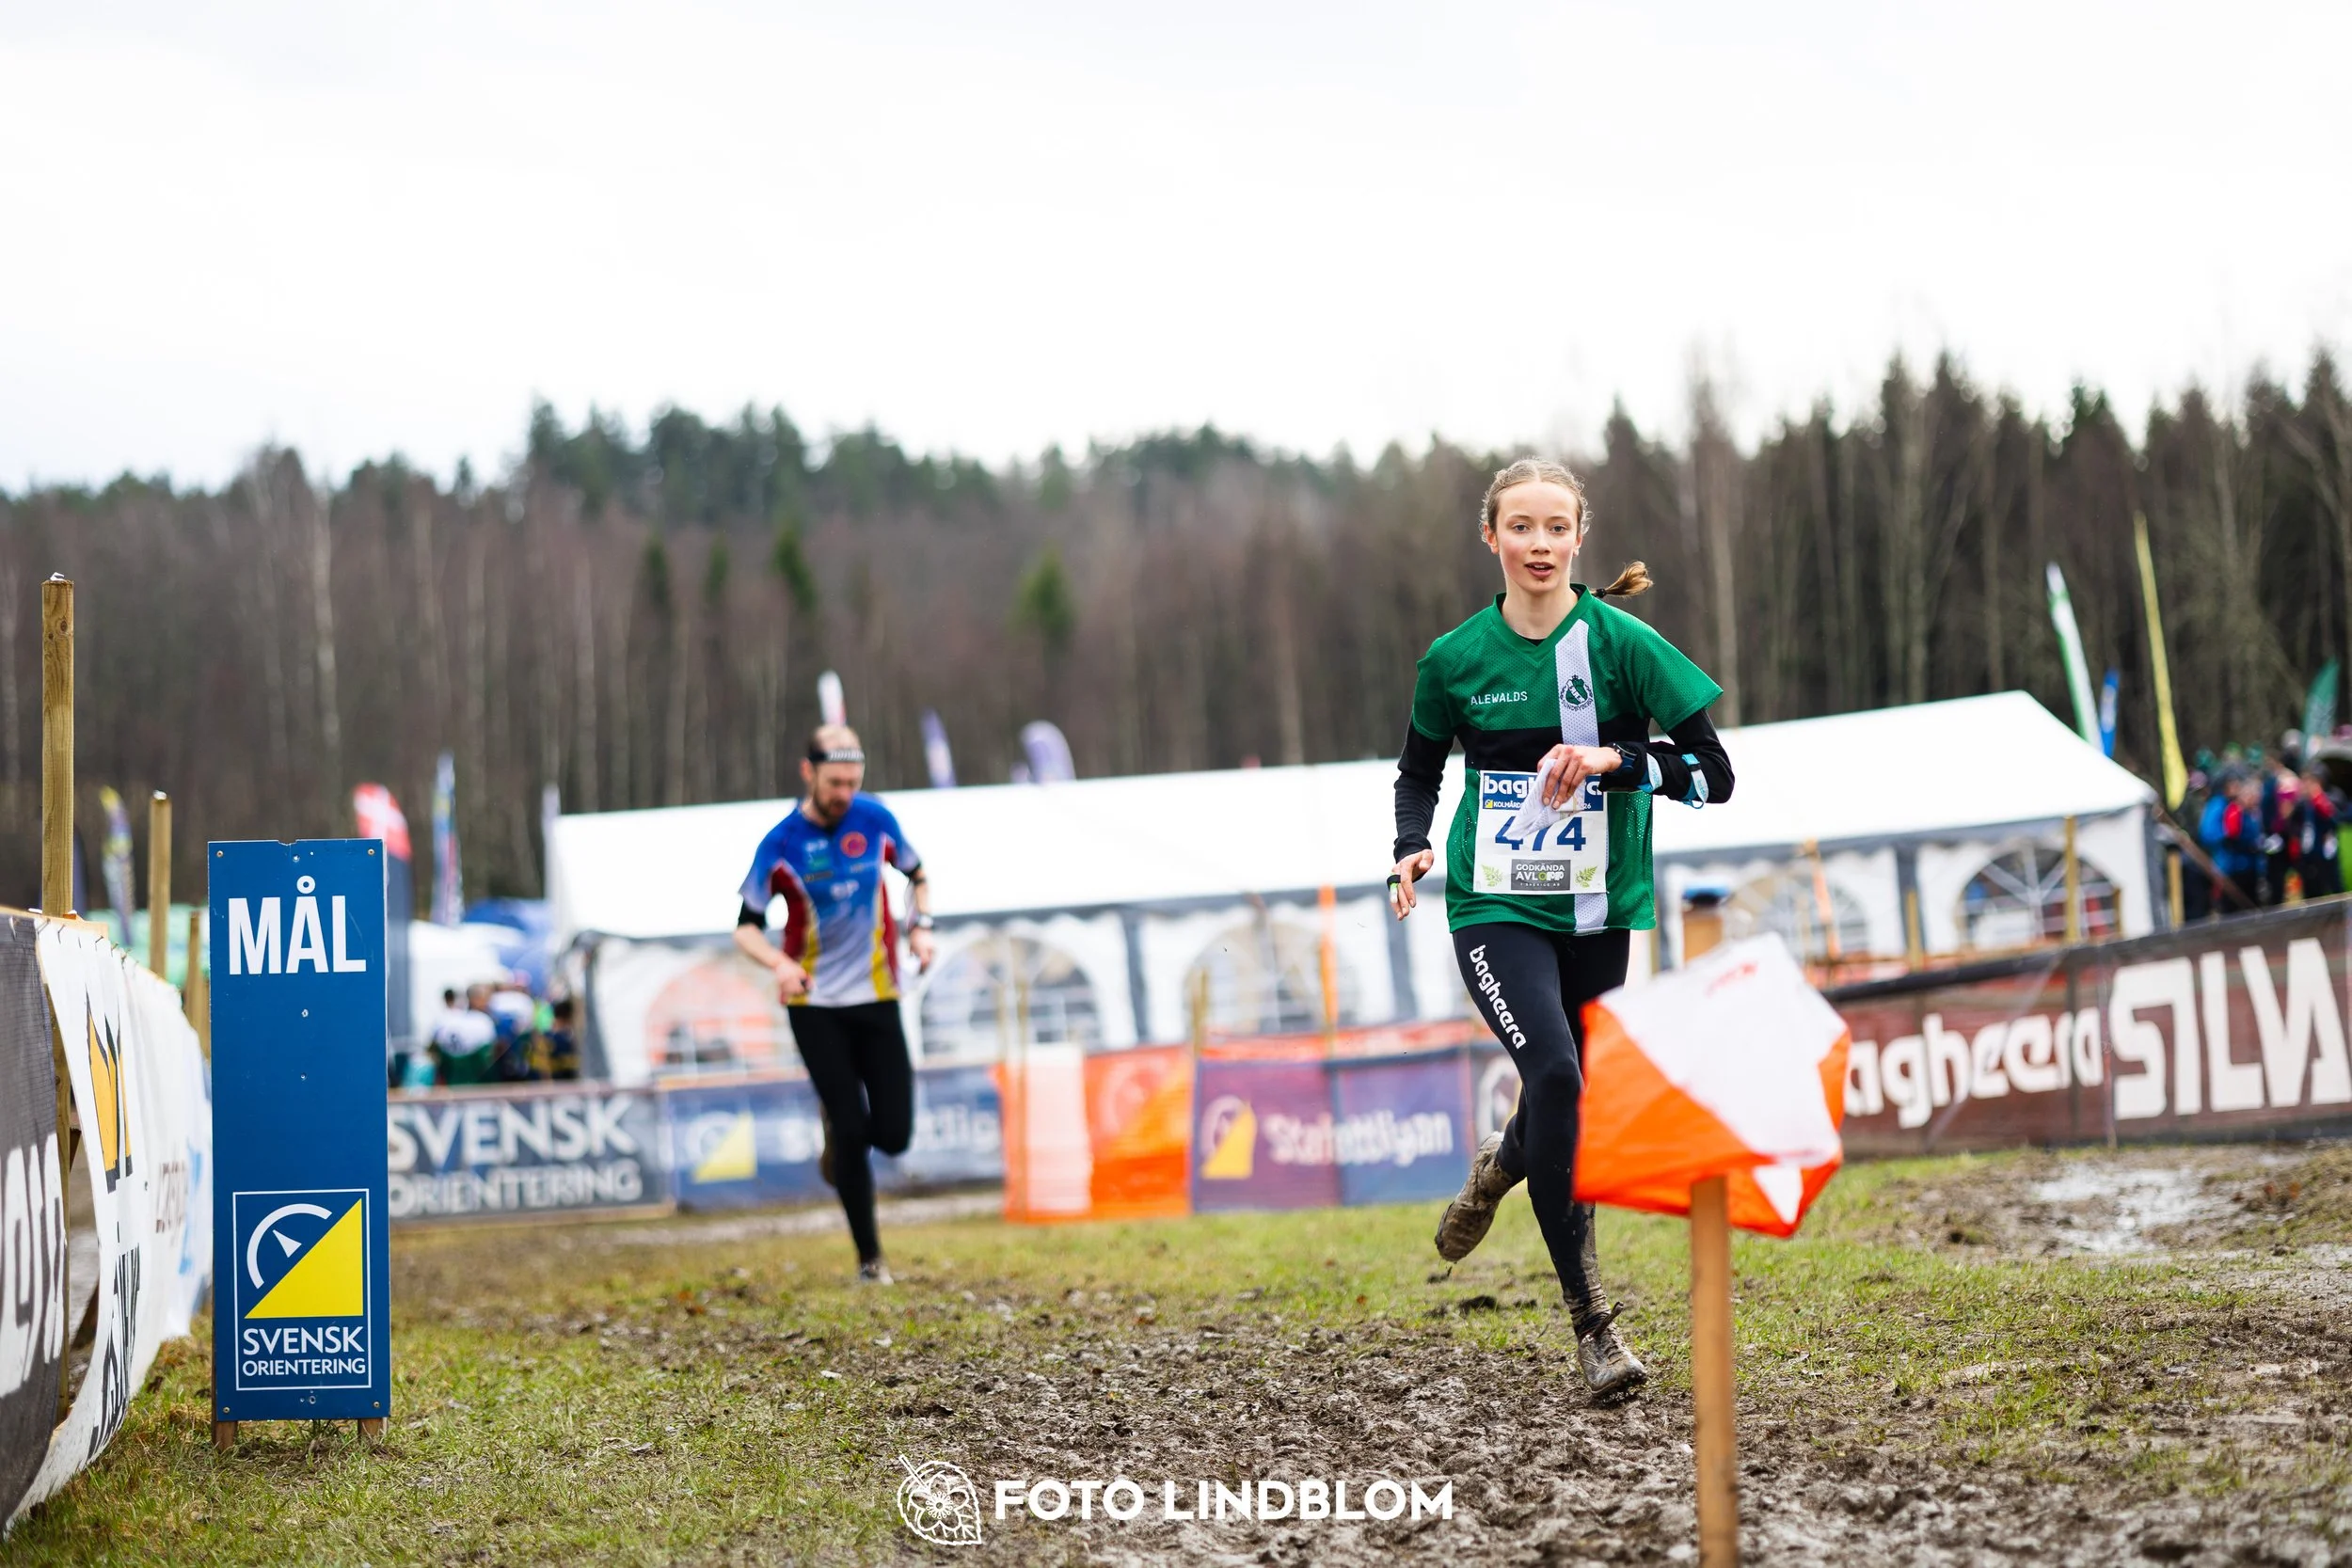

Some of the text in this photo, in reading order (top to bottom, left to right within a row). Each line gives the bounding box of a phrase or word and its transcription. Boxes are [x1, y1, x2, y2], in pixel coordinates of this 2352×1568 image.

[1470, 691, 1528, 705] ALEWALDS
[1493, 800, 1521, 809] KOLMÅRD
[1516, 863, 1565, 871] GODKÄNDA
[229, 875, 367, 975] MÅL
[1470, 944, 1526, 1049] bagheera
[1844, 937, 2352, 1129] agheera SILVA
[388, 1094, 639, 1171] SVENSK
[388, 1157, 643, 1217] ORIENTERING
[243, 1326, 365, 1355] SVENSK
[242, 1358, 366, 1376] ORIENTERING
